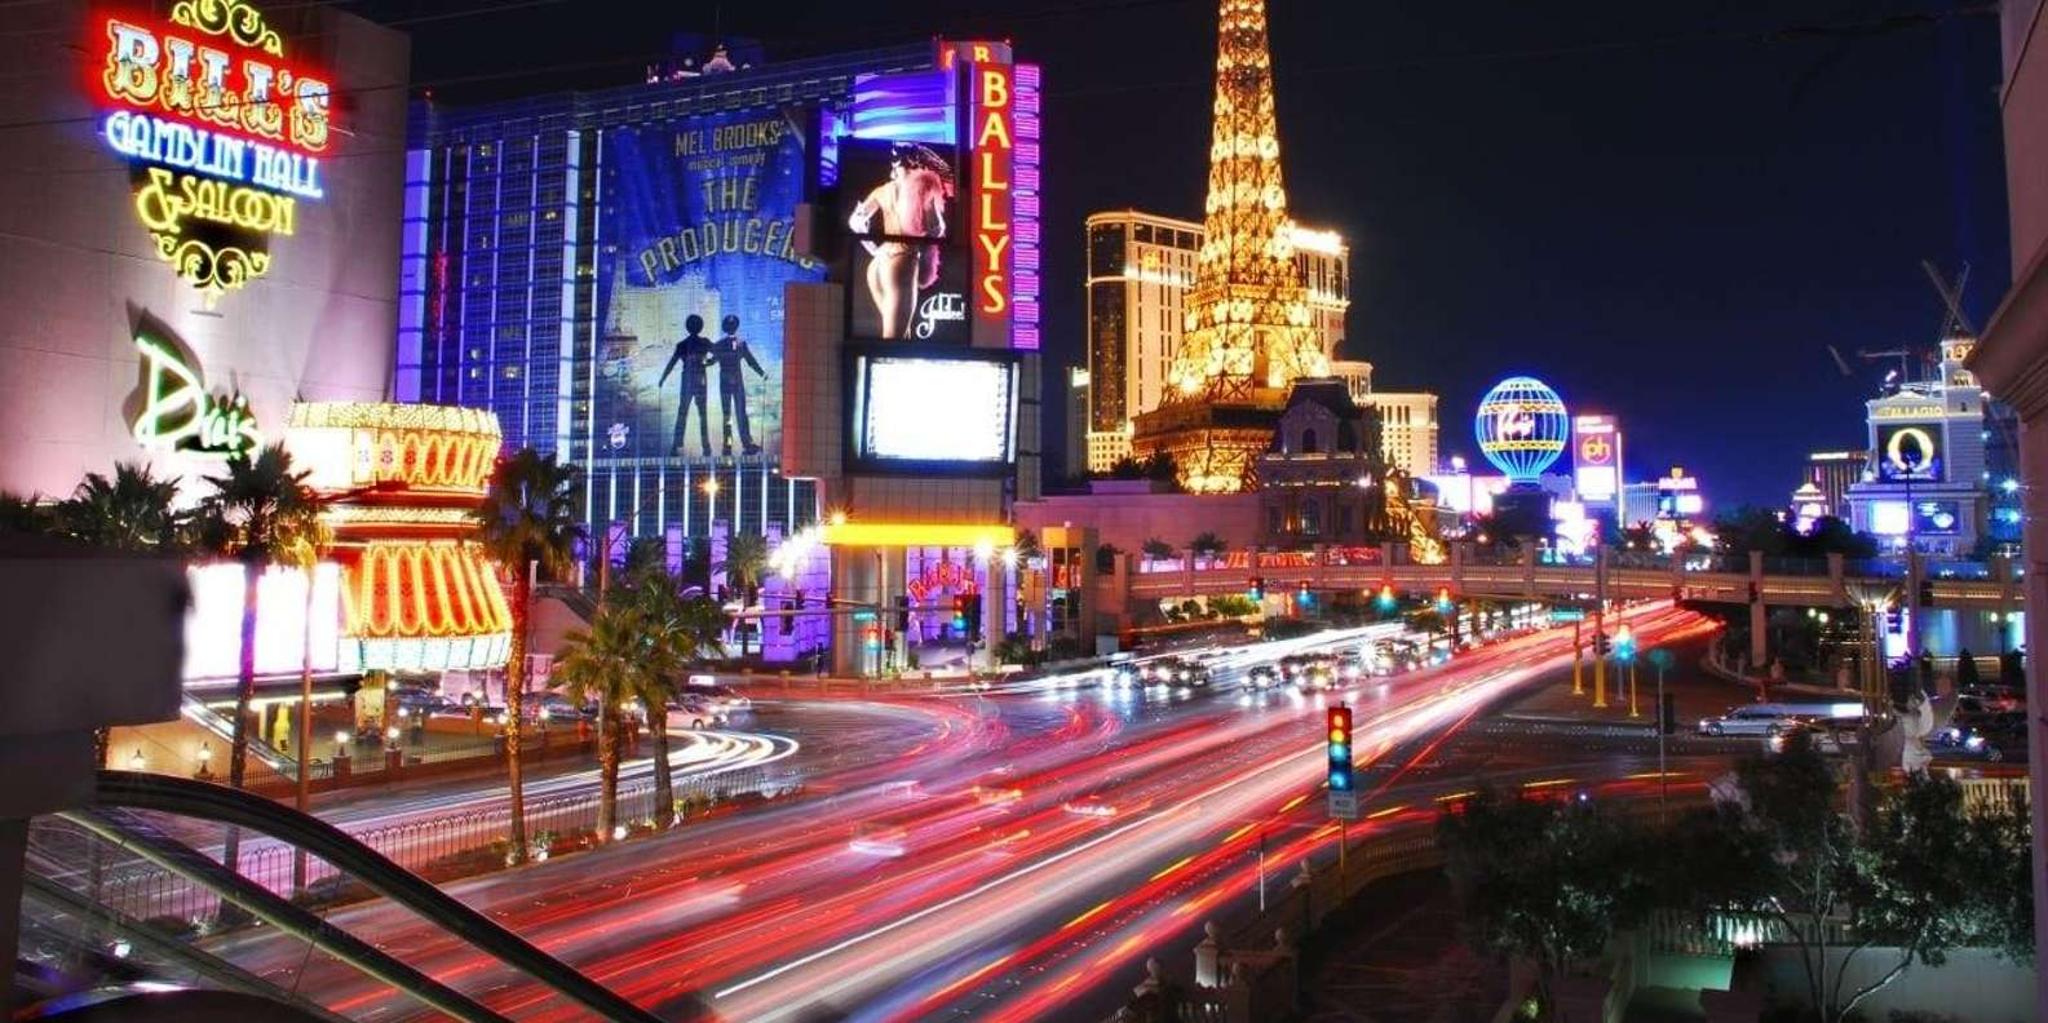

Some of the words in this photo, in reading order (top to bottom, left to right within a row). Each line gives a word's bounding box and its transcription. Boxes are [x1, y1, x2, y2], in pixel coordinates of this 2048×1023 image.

[103, 19, 330, 150] BILL'S
[252, 145, 323, 198] HALL
[675, 131, 707, 157] MEL
[137, 166, 183, 233] &
[180, 175, 295, 235] SALOON
[703, 177, 758, 213] THE
[978, 70, 1011, 313] BALLYS
[640, 217, 815, 281] PRODUCER
